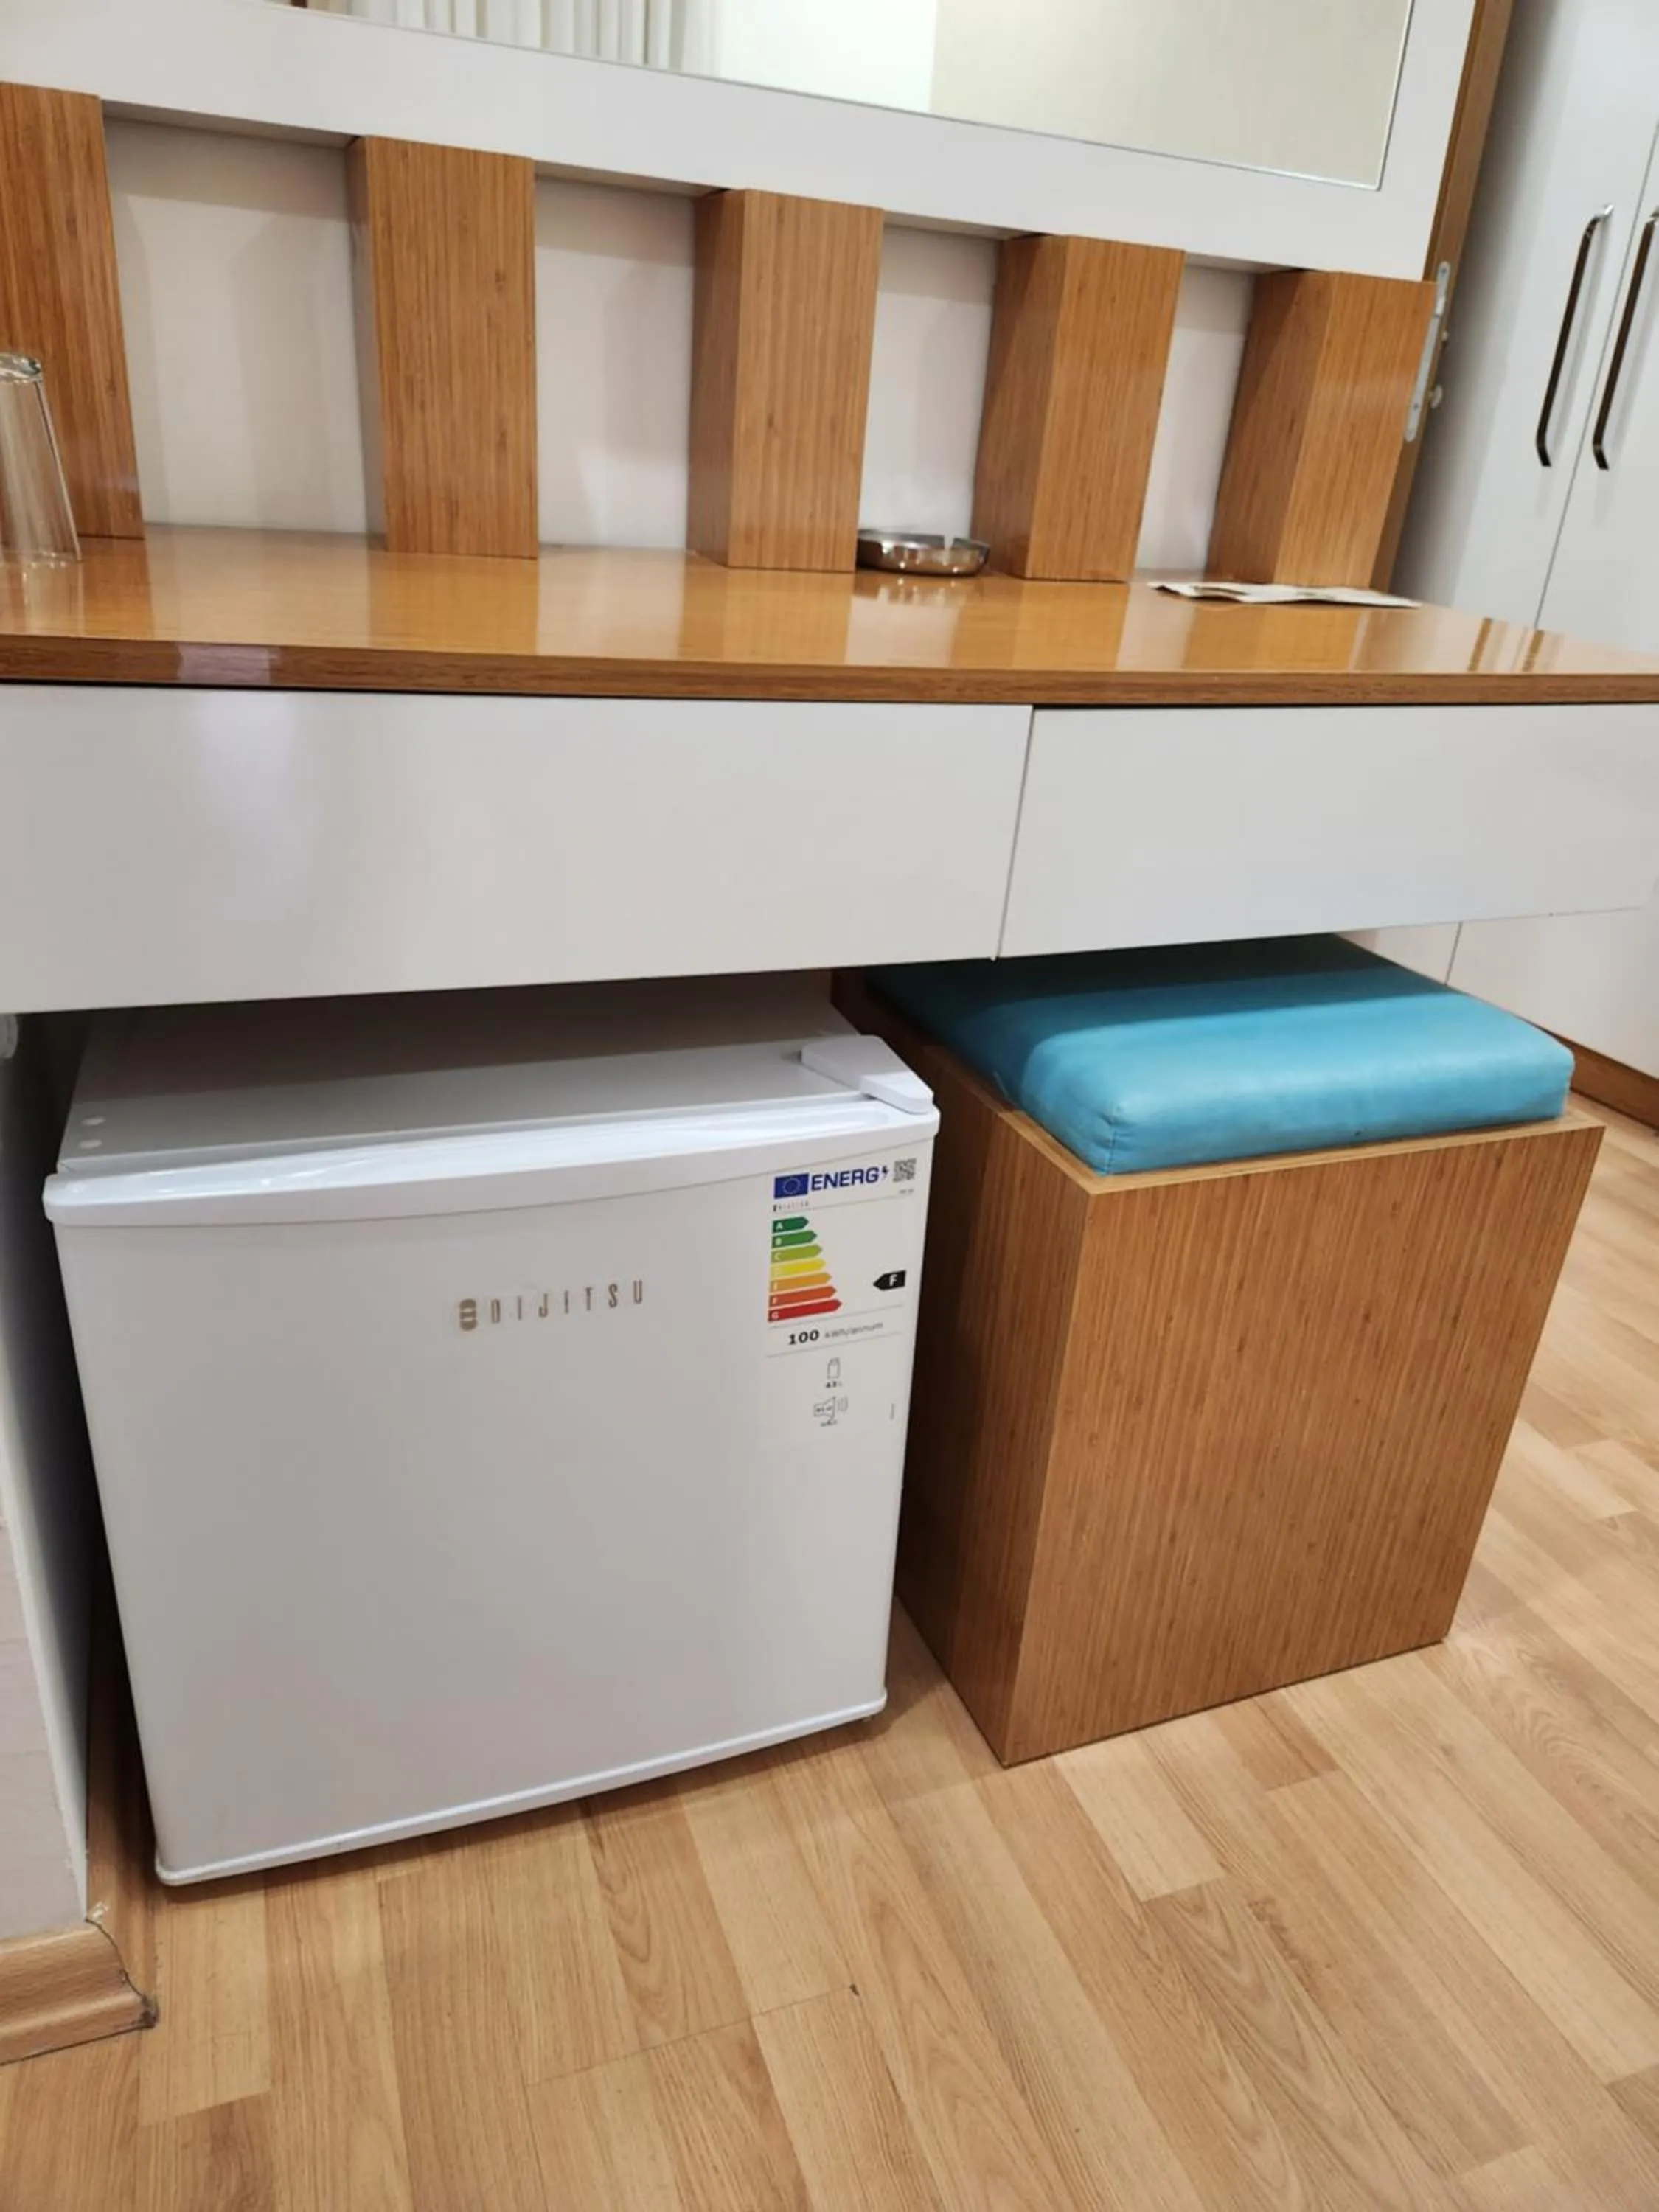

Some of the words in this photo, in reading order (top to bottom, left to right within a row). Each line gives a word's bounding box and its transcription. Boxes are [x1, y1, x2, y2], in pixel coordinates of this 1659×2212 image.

[889, 1274, 897, 1286] F
[490, 1279, 644, 1324] DIJITSU
[788, 1329, 819, 1345] 100
